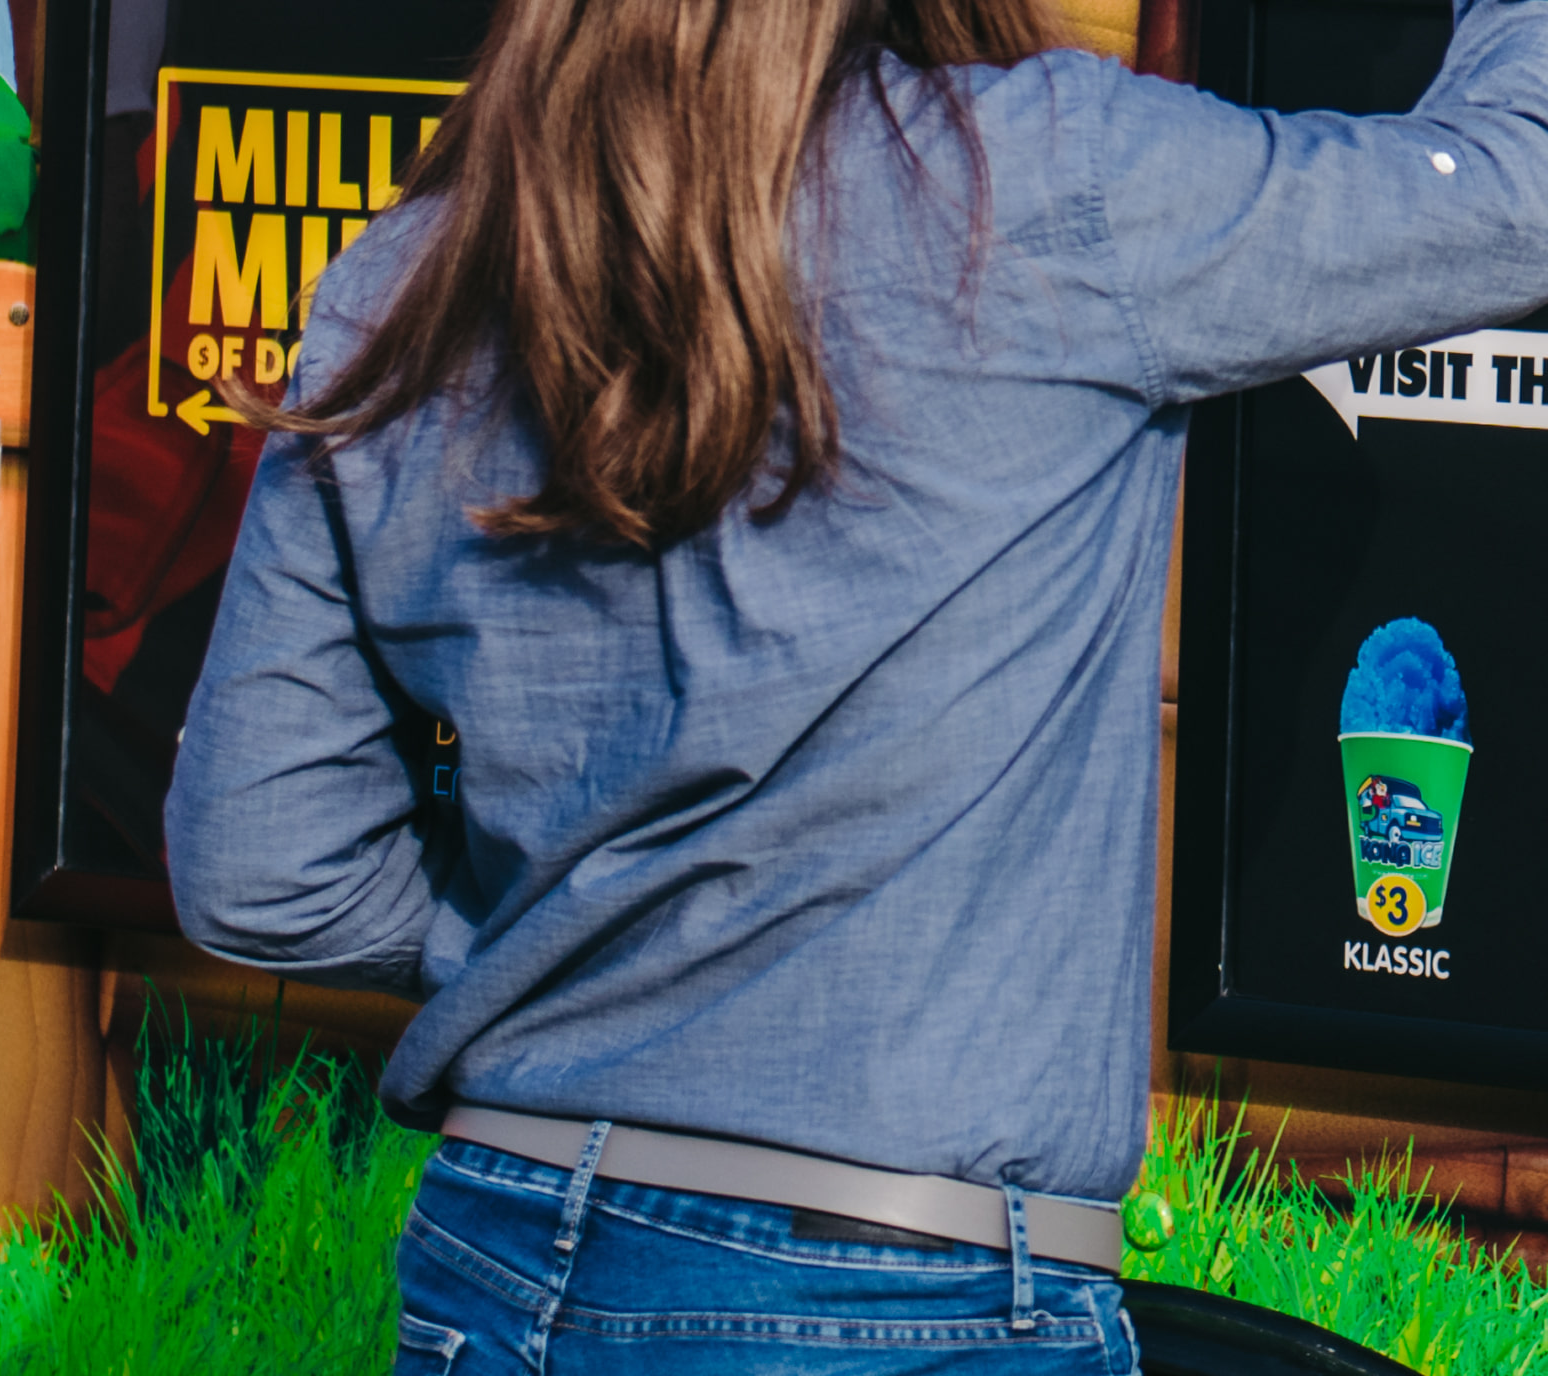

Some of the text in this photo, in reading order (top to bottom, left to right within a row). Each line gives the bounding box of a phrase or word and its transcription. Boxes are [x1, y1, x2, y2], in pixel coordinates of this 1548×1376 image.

[1348, 348, 1474, 401] VISIT
[1375, 883, 1409, 926] $3
[1343, 941, 1451, 979] KLASSIC
